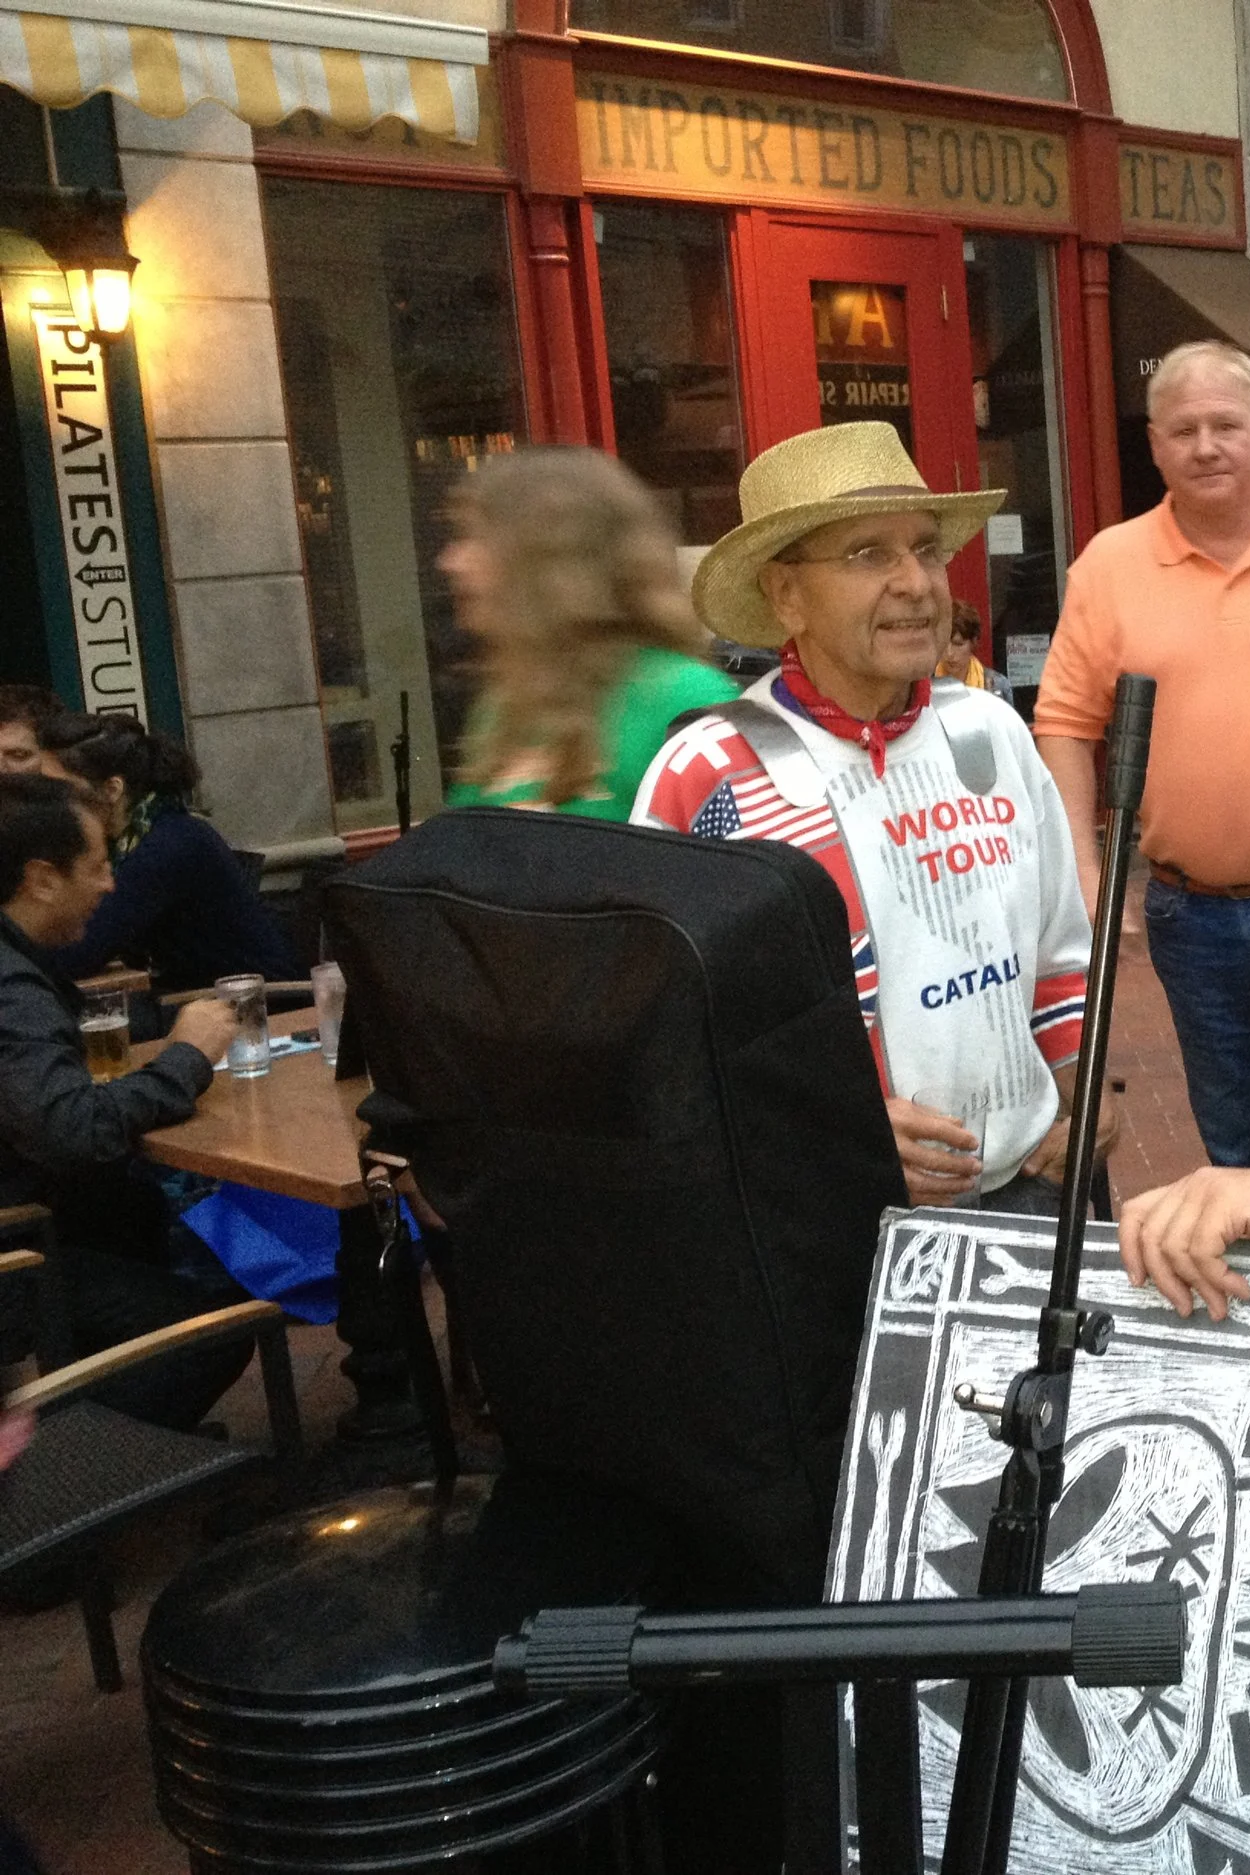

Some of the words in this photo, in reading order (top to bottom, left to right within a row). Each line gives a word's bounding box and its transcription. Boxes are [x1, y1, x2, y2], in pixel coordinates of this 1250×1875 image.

[590, 81, 883, 192] IMPORTED
[902, 121, 1058, 209] FOODS
[1122, 148, 1226, 225] TEAS
[47, 323, 118, 555] PILATES
[82, 568, 124, 581] ENTER
[882, 796, 1016, 847] WORLD
[917, 837, 1012, 884] TOUR
